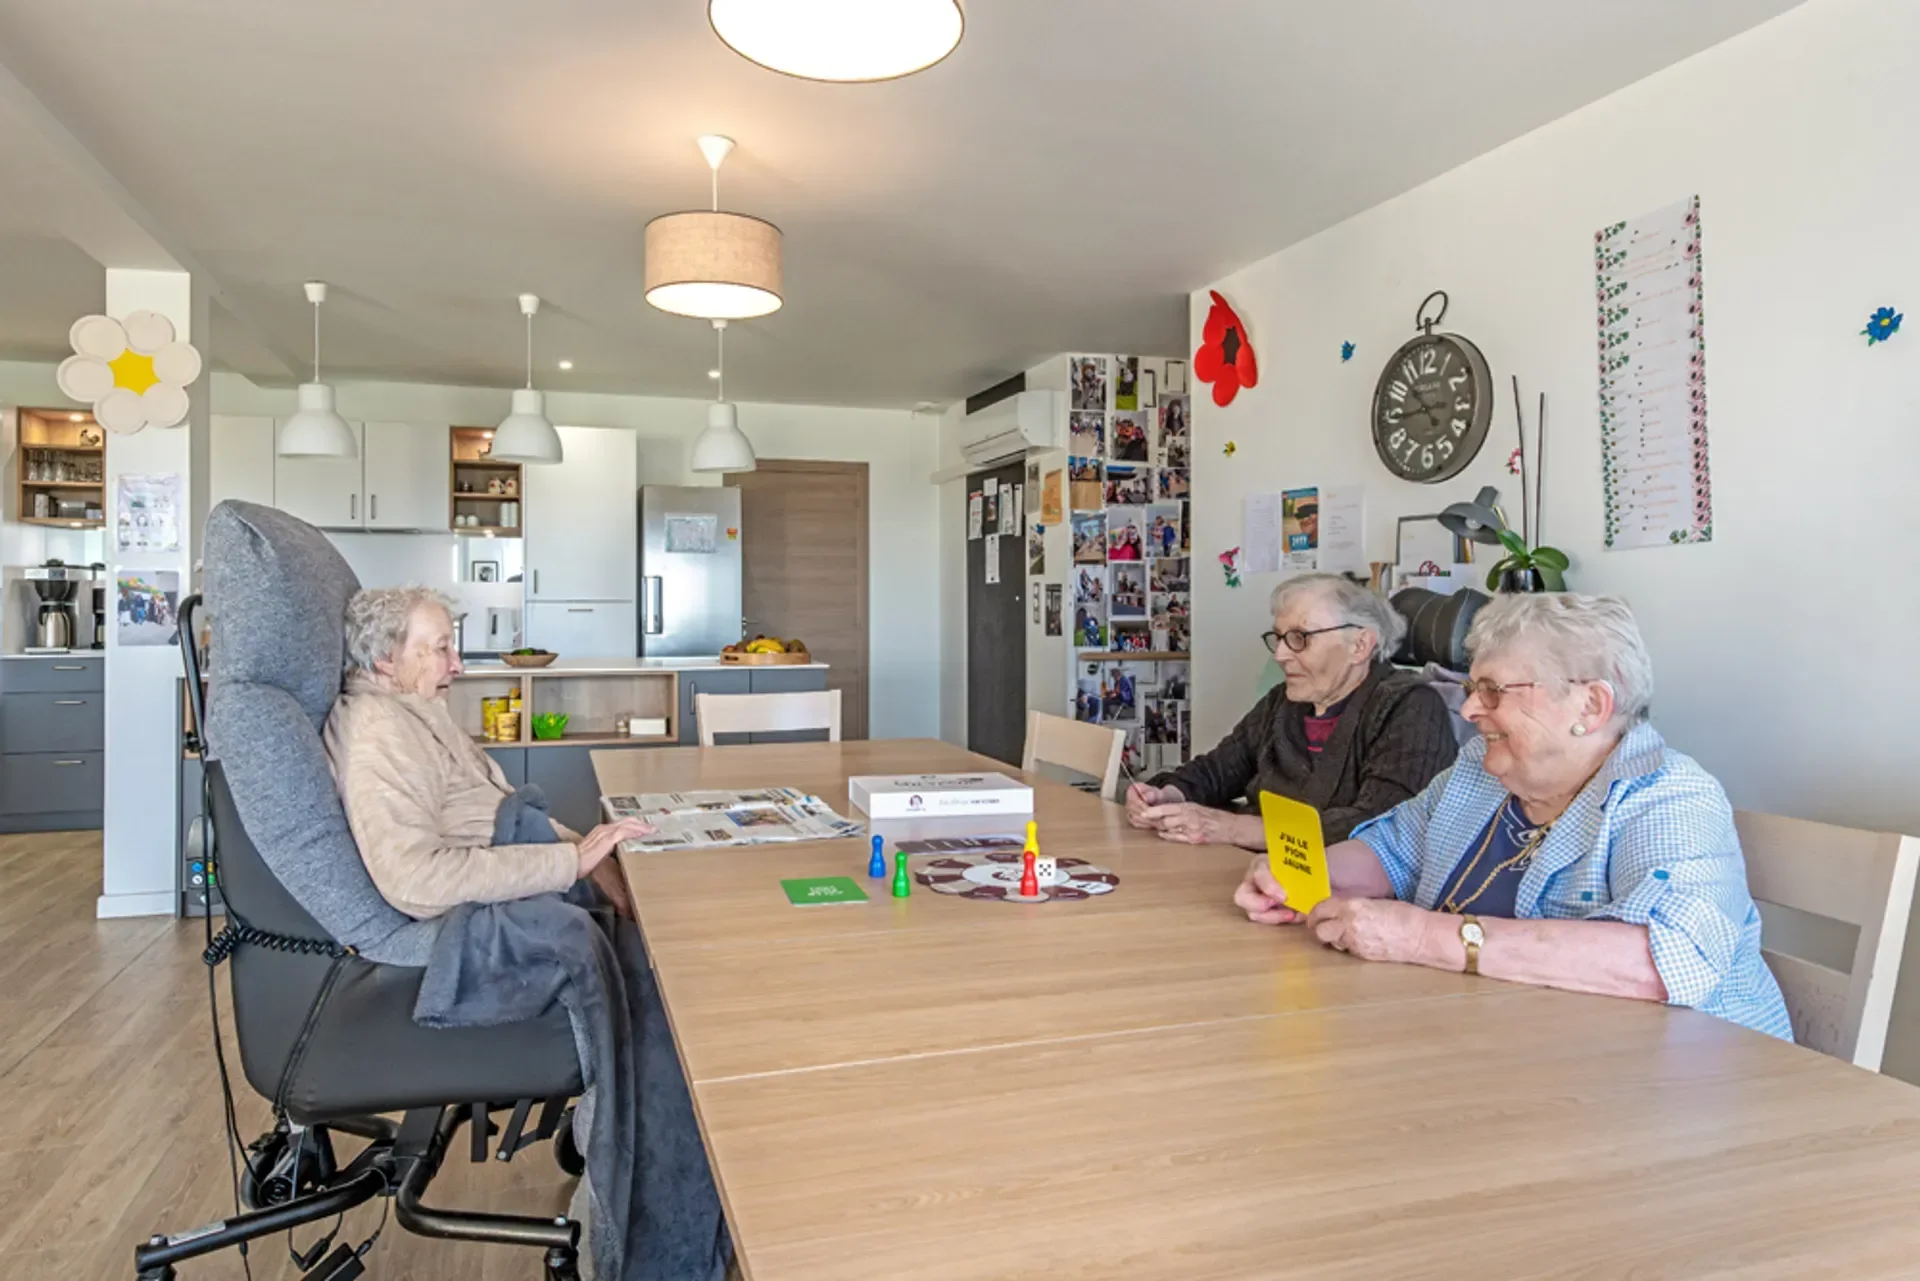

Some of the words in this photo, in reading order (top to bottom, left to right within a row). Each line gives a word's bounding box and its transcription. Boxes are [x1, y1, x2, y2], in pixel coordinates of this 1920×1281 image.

[1403, 359, 1419, 385] 11
[1420, 349, 1437, 375] 12
[1440, 352, 1451, 376] 1
[1449, 368, 1468, 391] 2
[1389, 380, 1409, 403] 10
[1455, 395, 1470, 411] 3
[1389, 428, 1406, 450] 8
[1451, 418, 1466, 437] 4
[1404, 440, 1420, 463] 7
[1421, 444, 1434, 469] 6
[1436, 434, 1453, 459] 5
